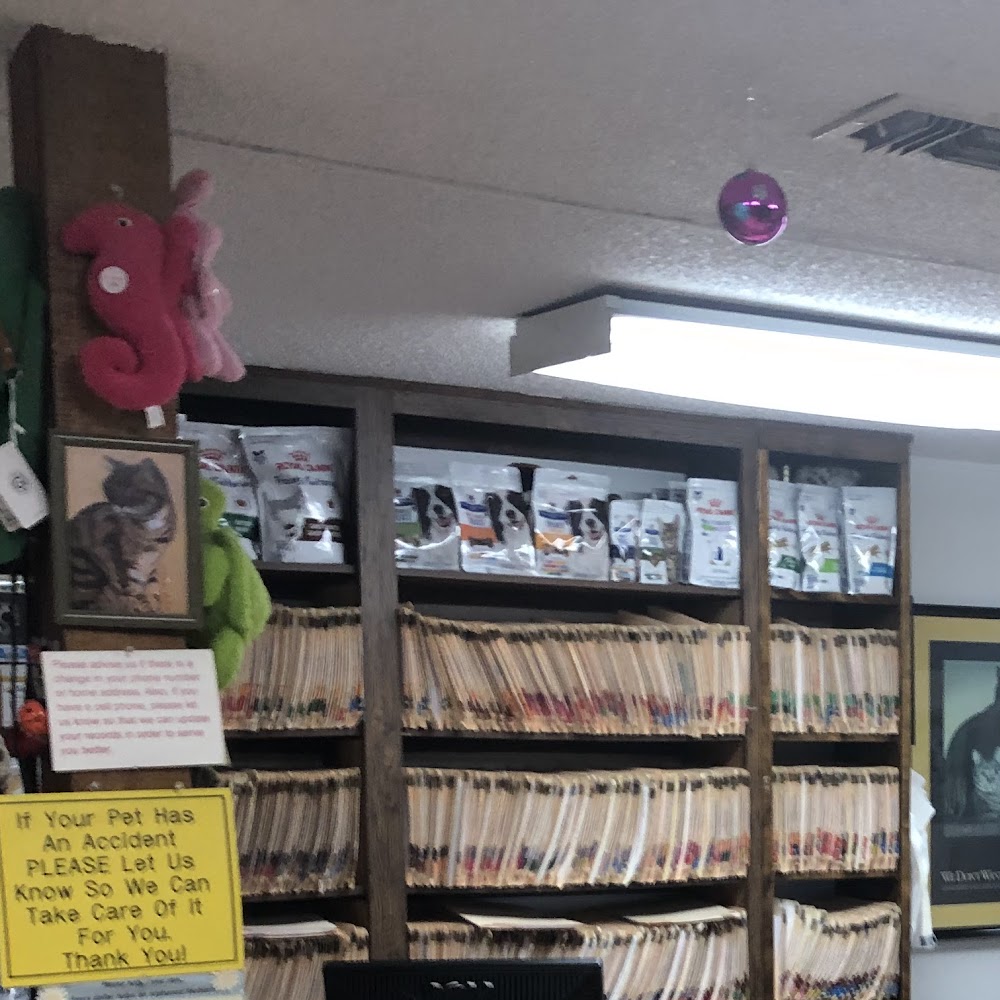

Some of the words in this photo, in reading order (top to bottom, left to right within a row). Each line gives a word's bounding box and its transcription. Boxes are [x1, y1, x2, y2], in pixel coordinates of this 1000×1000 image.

[16, 811, 32, 829] If
[45, 811, 95, 828] Your
[106, 808, 143, 826] Pet
[154, 807, 196, 824] Has
[42, 834, 71, 851] An
[83, 830, 177, 850] Accident
[26, 856, 110, 877] PLEASE
[121, 853, 156, 872] Let
[167, 853, 196, 871] Us
[14, 884, 74, 901] Know
[85, 880, 114, 898] So
[124, 878, 159, 895] We
[169, 875, 211, 893] Can
[26, 906, 81, 925] Take
[91, 903, 142, 921] Care
[154, 899, 177, 917] Of
[189, 897, 203, 916] It
[77, 928, 114, 945] For
[62, 951, 130, 970] Thank
[141, 945, 188, 964] You!
